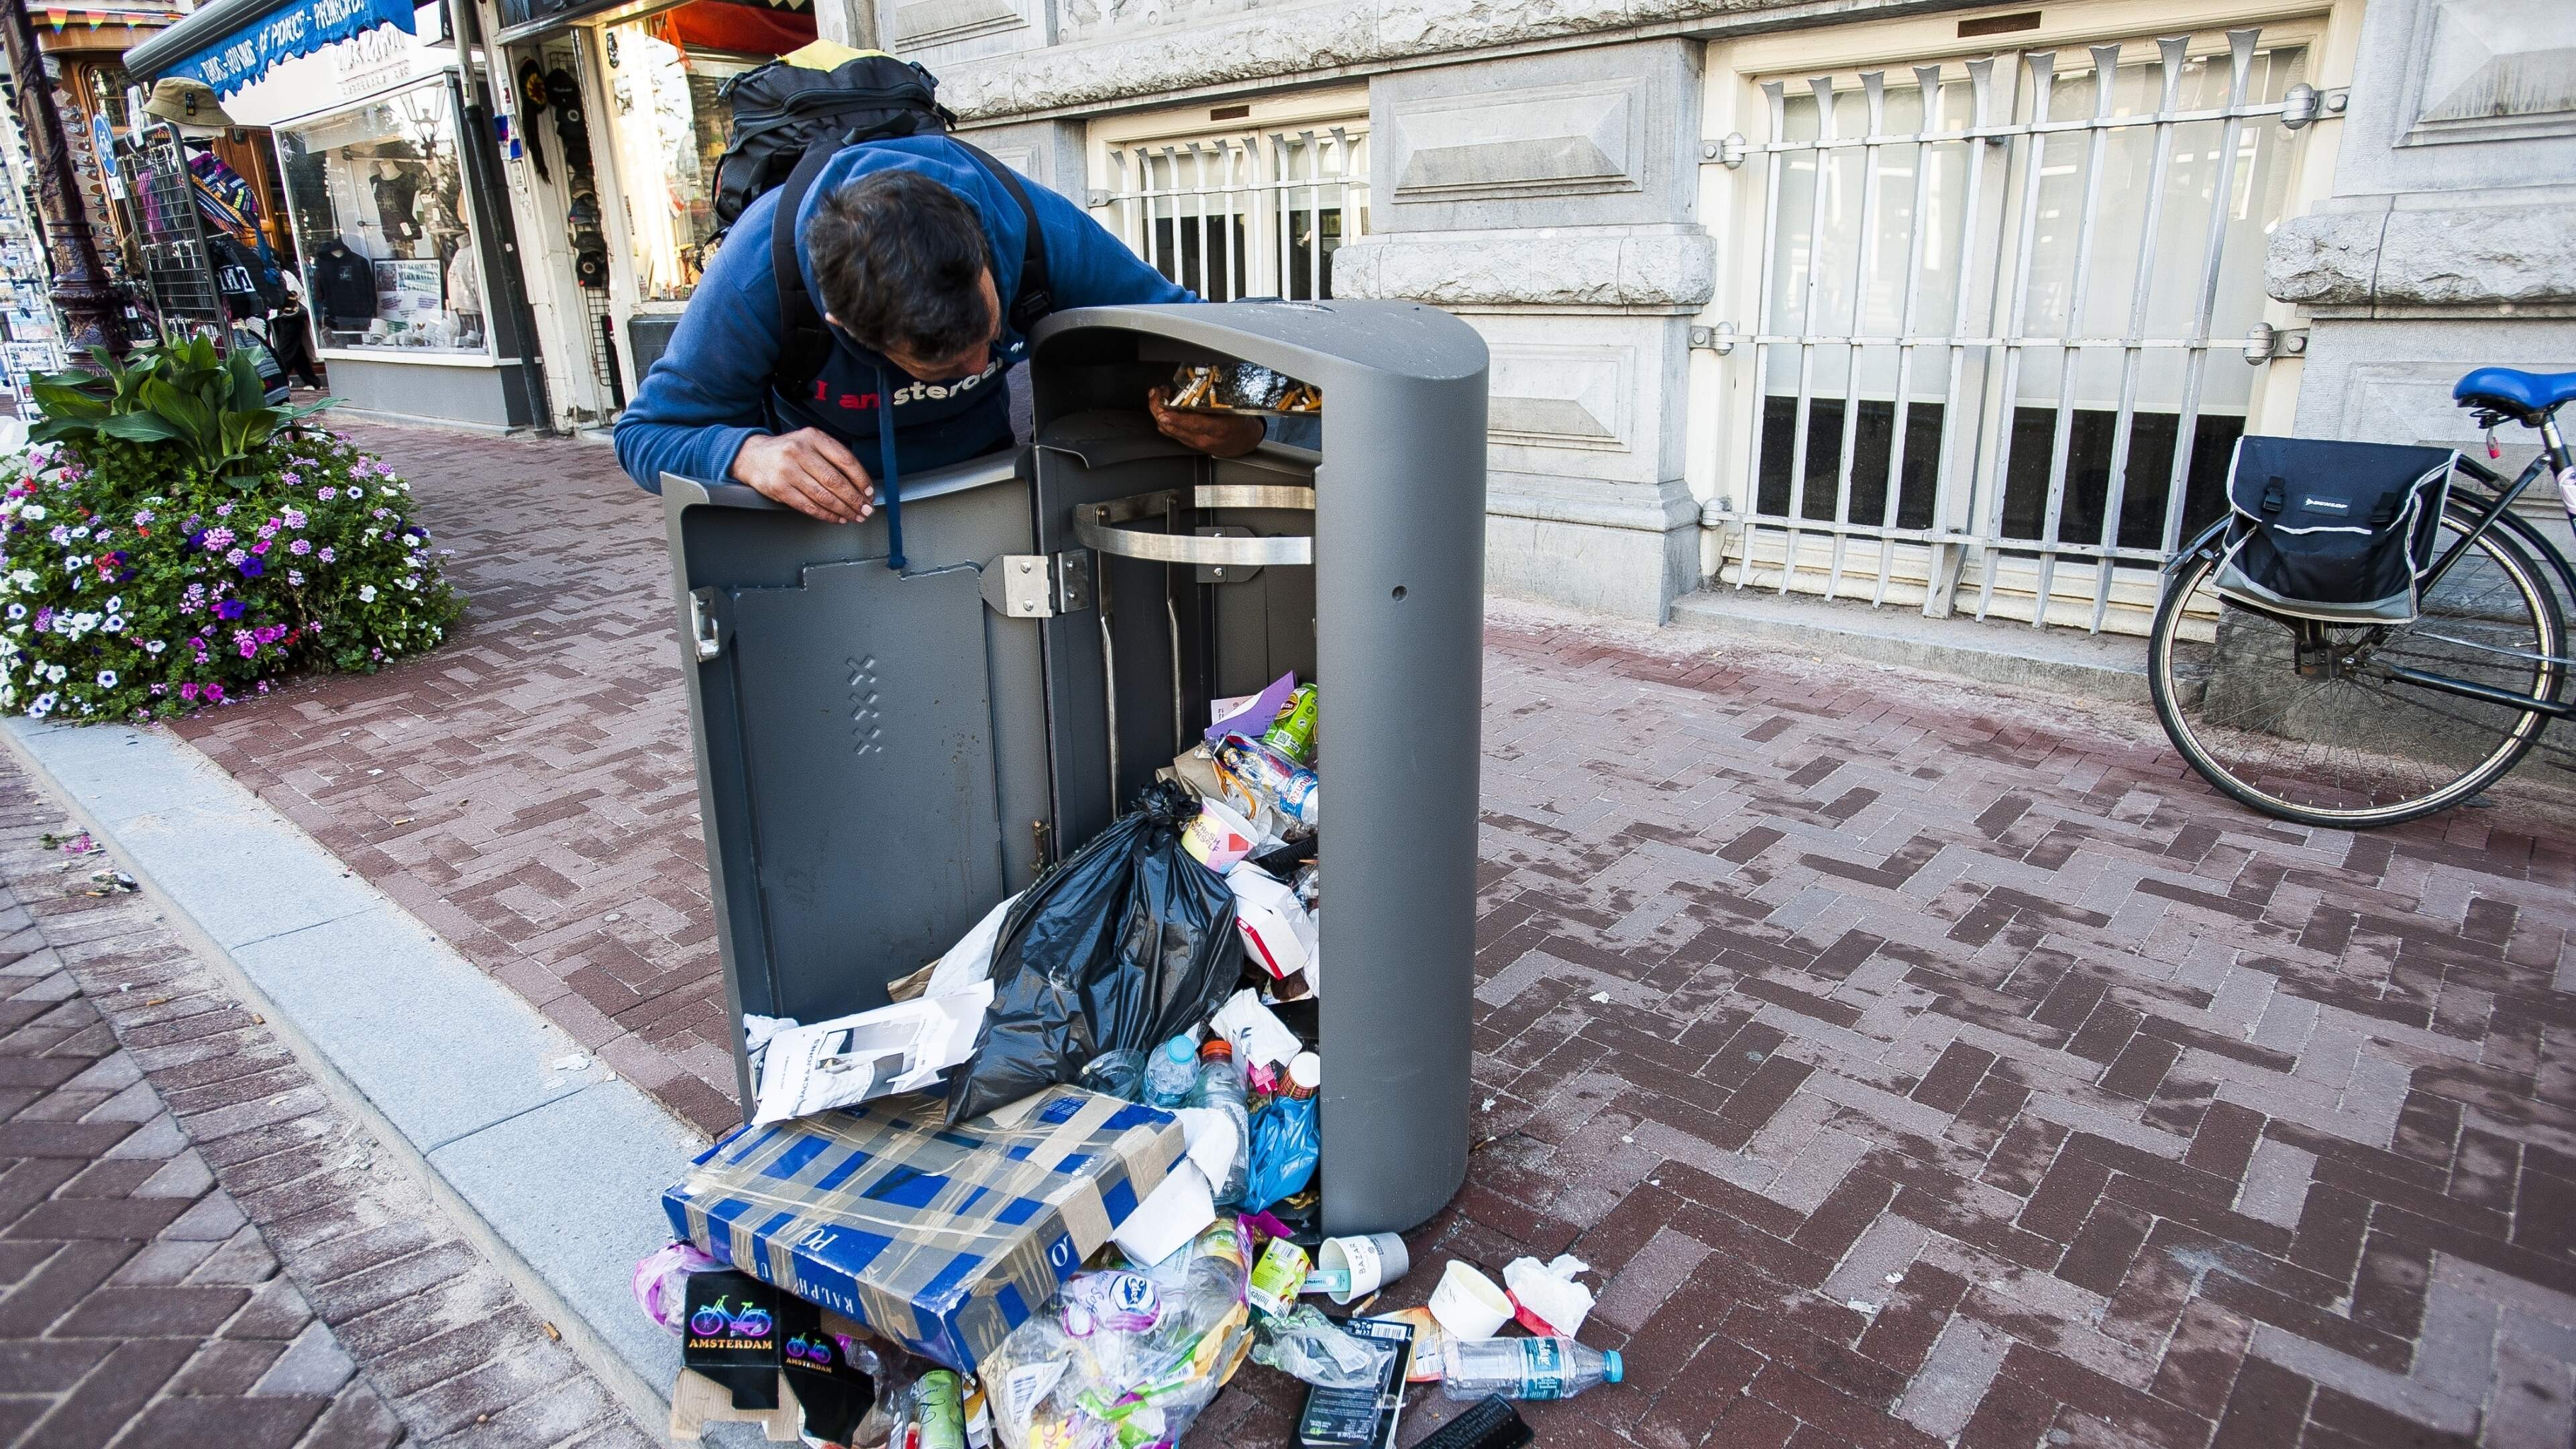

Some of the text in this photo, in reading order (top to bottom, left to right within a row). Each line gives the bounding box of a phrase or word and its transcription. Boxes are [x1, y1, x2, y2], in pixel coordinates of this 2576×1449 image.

[816, 380, 827, 400] I
[2312, 500, 2349, 508] DUNLOP
[1349, 1243, 1366, 1275] BAZAR
[798, 1278, 854, 1313] RALPH
[1250, 1290, 1270, 1307] hohes
[689, 1338, 773, 1350] AMSTERDAM
[786, 1357, 833, 1374] AMSTERDAM
